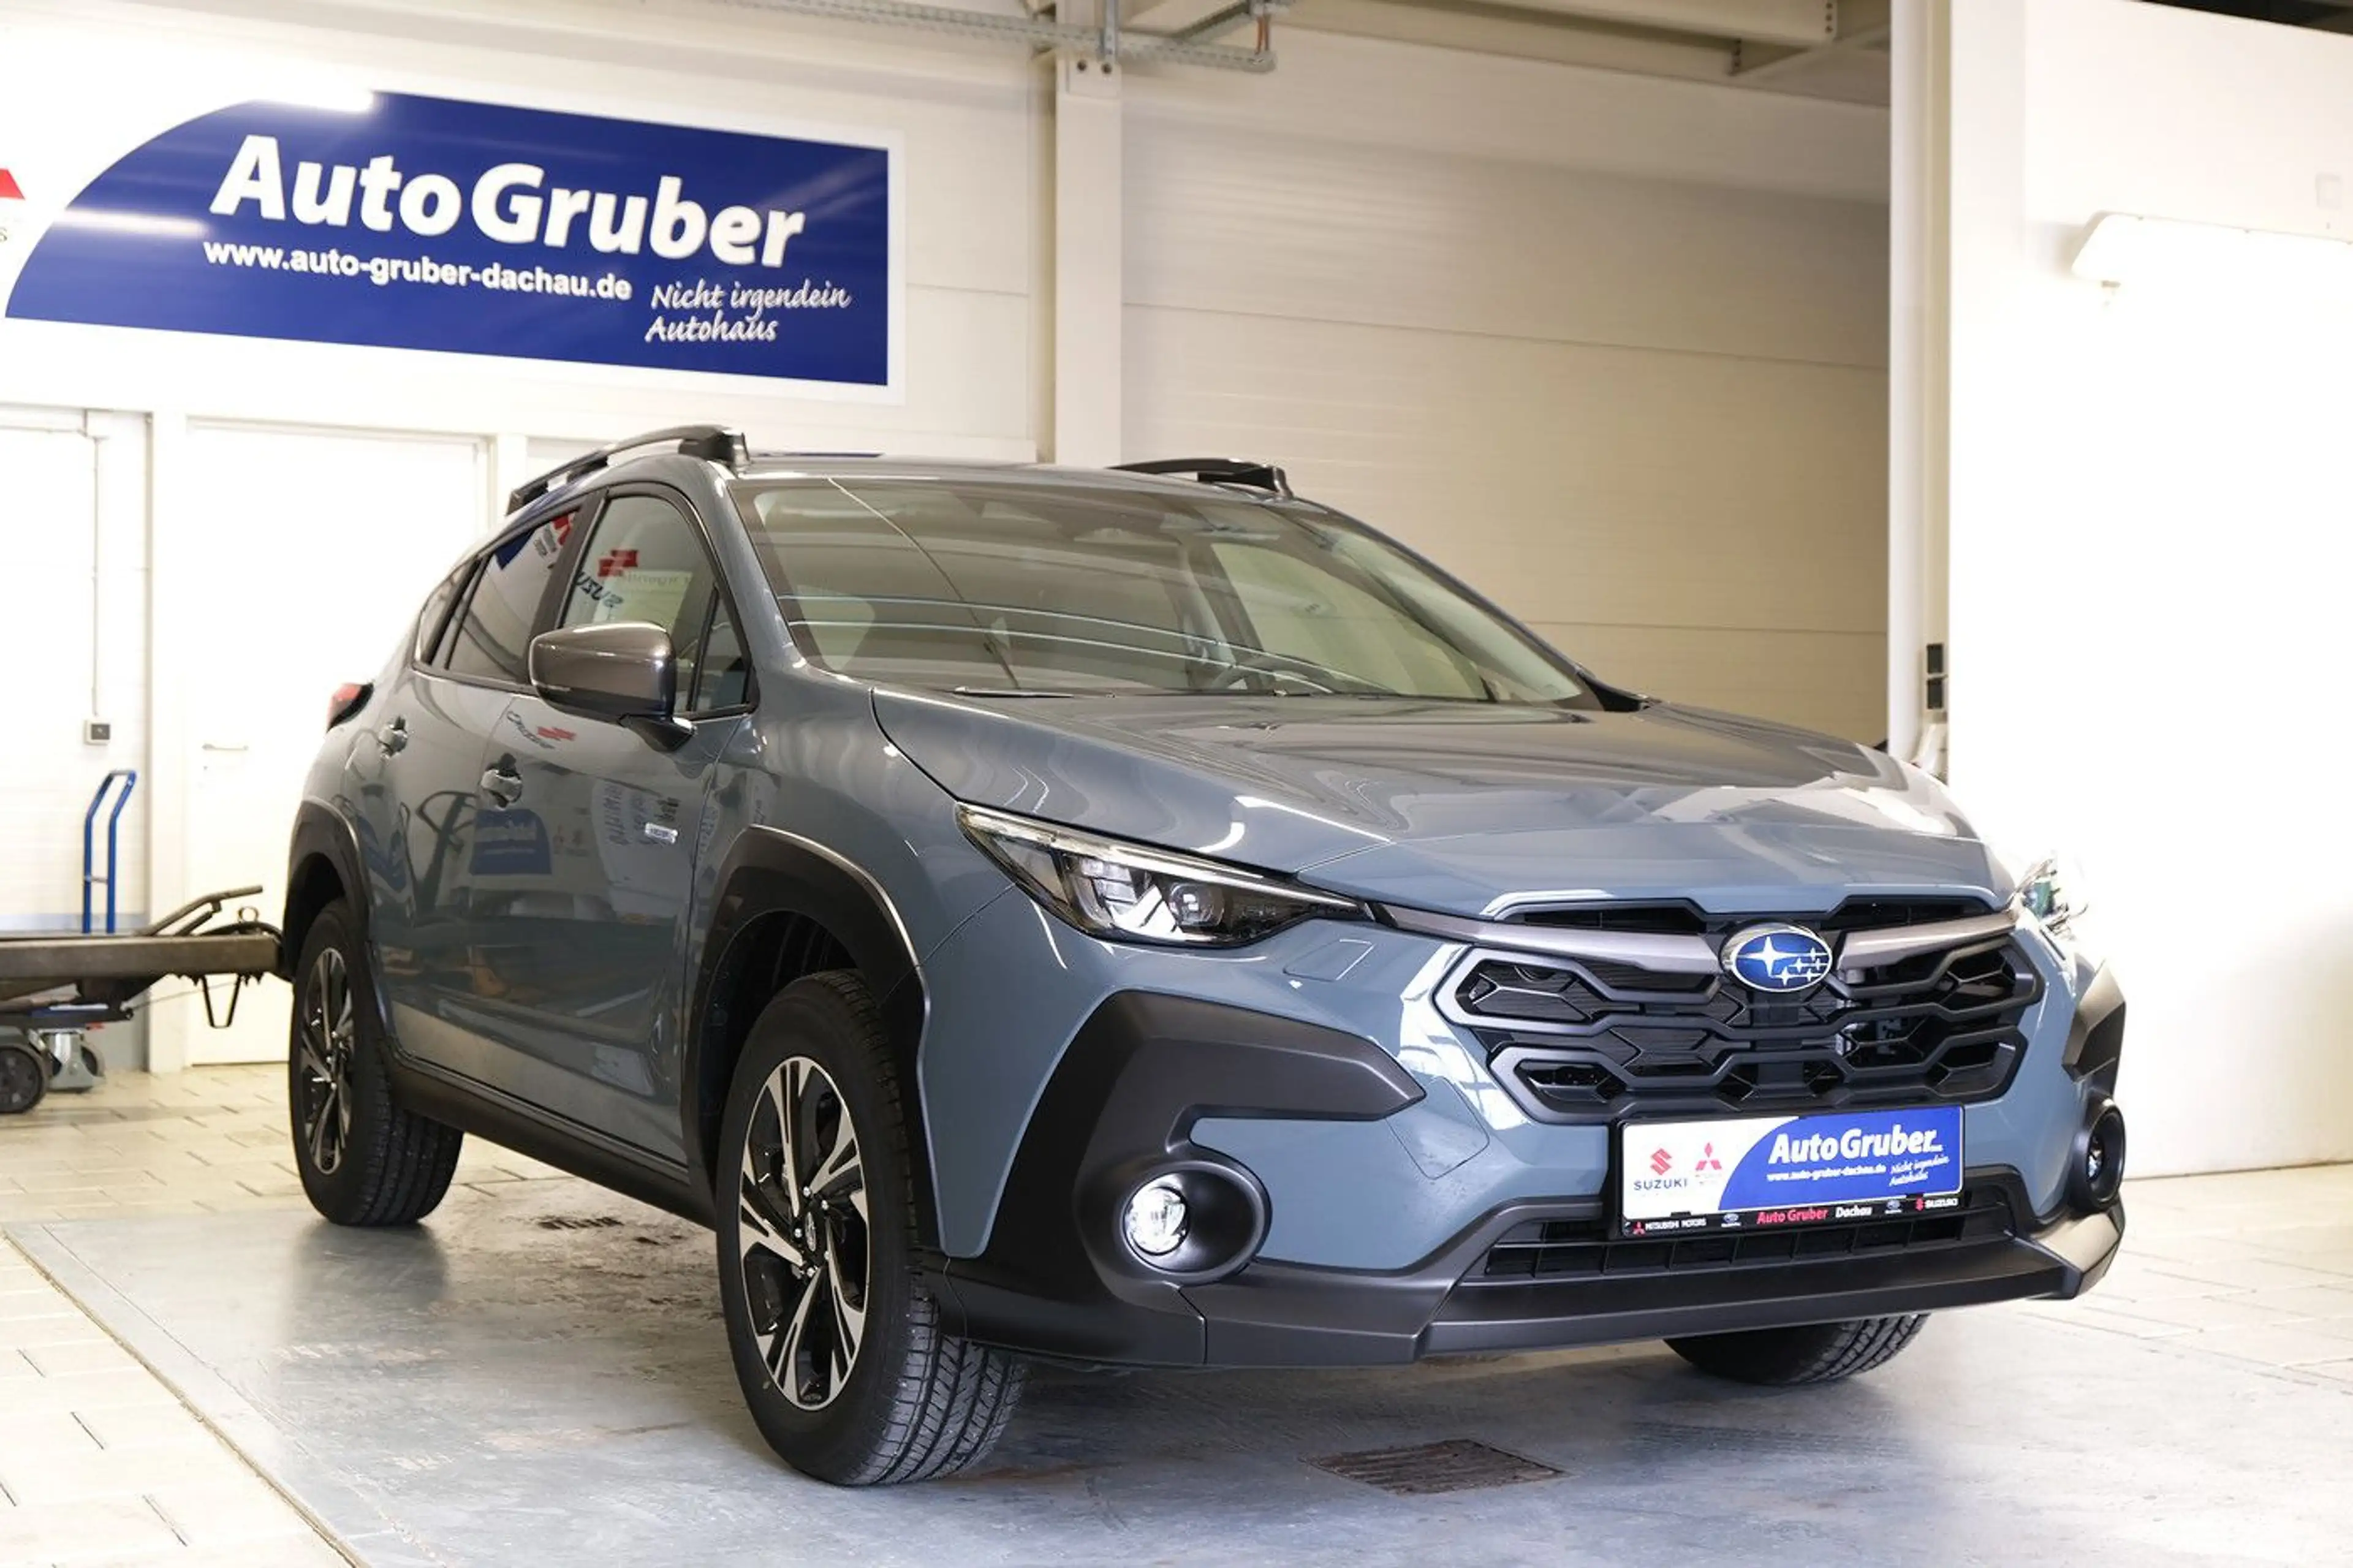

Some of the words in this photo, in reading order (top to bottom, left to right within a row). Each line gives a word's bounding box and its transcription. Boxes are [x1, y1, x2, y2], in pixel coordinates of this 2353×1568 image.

[203, 240, 632, 301] www.auto-gruber-dachau.de
[650, 278, 727, 309] Nicht
[730, 279, 852, 321] irgendein
[645, 311, 779, 343] Autohaus
[1634, 1178, 1688, 1191] SUZUKI
[1756, 1211, 1786, 1224] Auto
[1787, 1207, 1828, 1222] Gruber
[1835, 1205, 1873, 1218] Dachau
